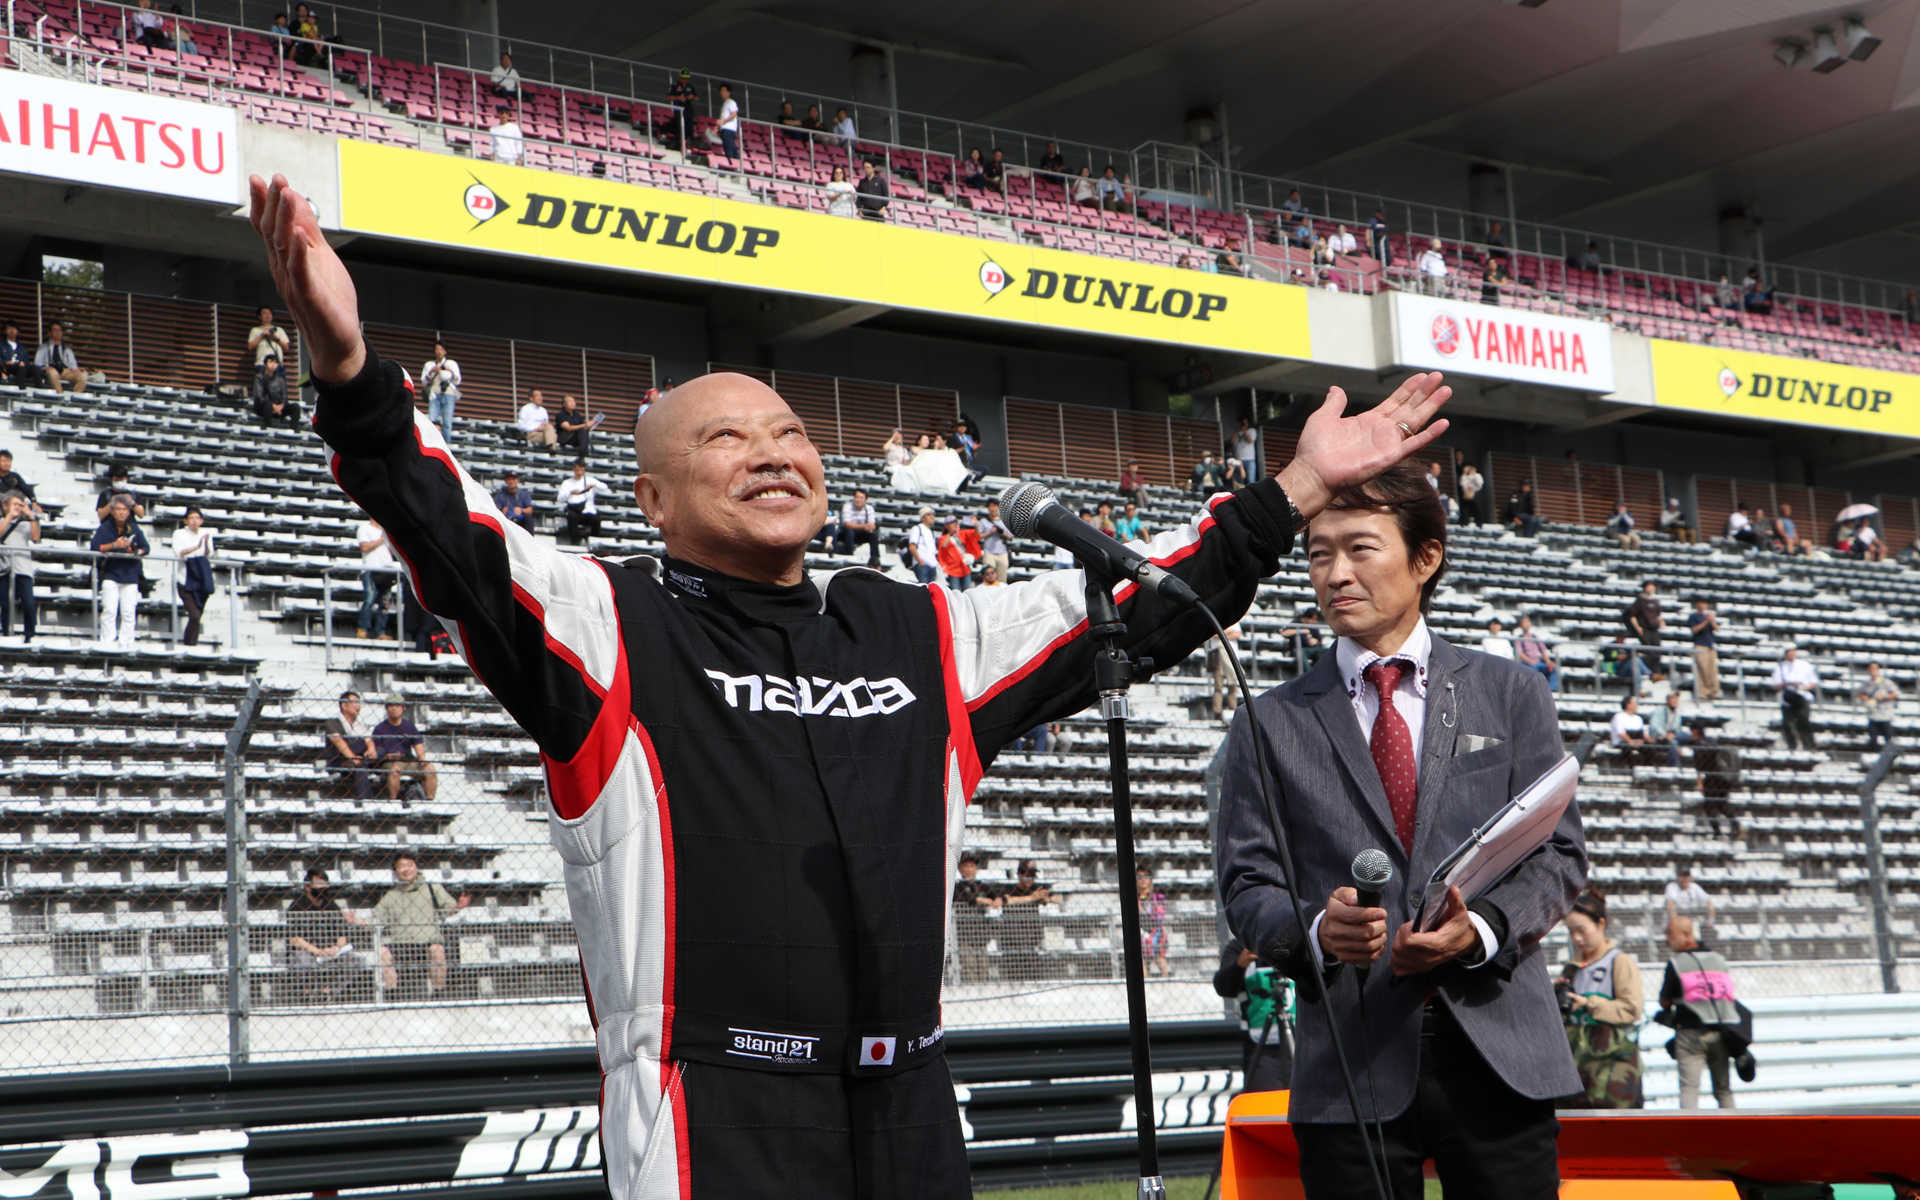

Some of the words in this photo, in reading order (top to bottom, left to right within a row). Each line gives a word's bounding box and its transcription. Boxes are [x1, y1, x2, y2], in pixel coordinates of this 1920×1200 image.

[516, 192, 781, 259] DUNLOP
[1020, 267, 1228, 322] DUNLOP
[1464, 316, 1589, 375] YAMAHA
[1748, 372, 1893, 413] DUNLOP
[703, 667, 917, 718] mazda
